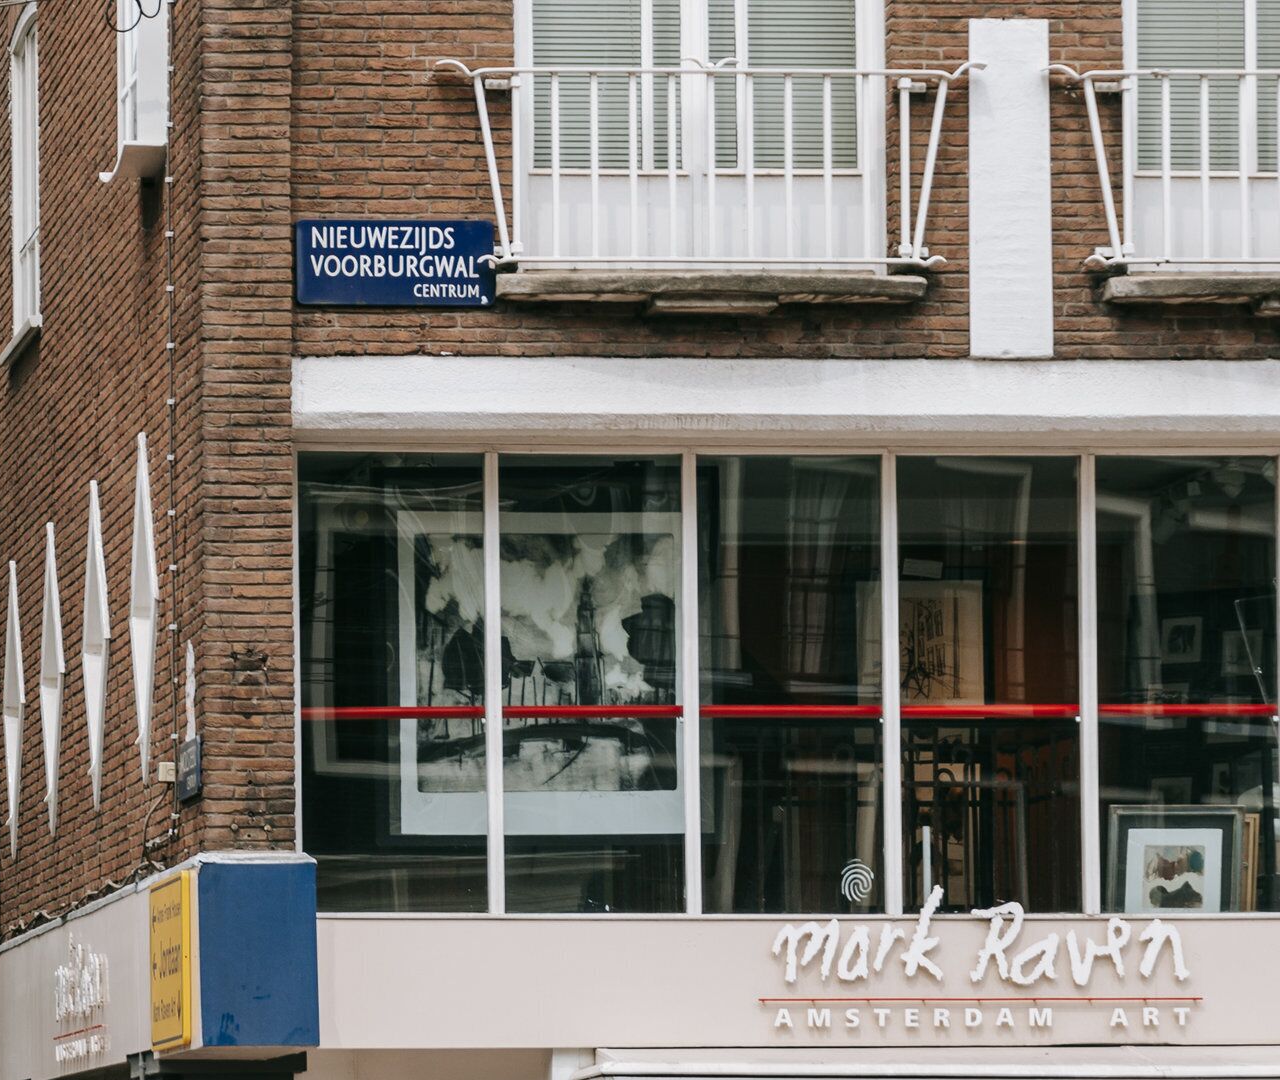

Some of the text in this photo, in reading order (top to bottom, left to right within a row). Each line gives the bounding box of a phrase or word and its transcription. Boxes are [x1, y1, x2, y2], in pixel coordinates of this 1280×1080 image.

[311, 226, 455, 255] NIEUWEZIJDS
[310, 255, 480, 278] VOORBURGWAL
[413, 284, 480, 298] CENTRUM
[970, 902, 1191, 986] Raven
[774, 1007, 1191, 1028] AMSTERDAM ART
